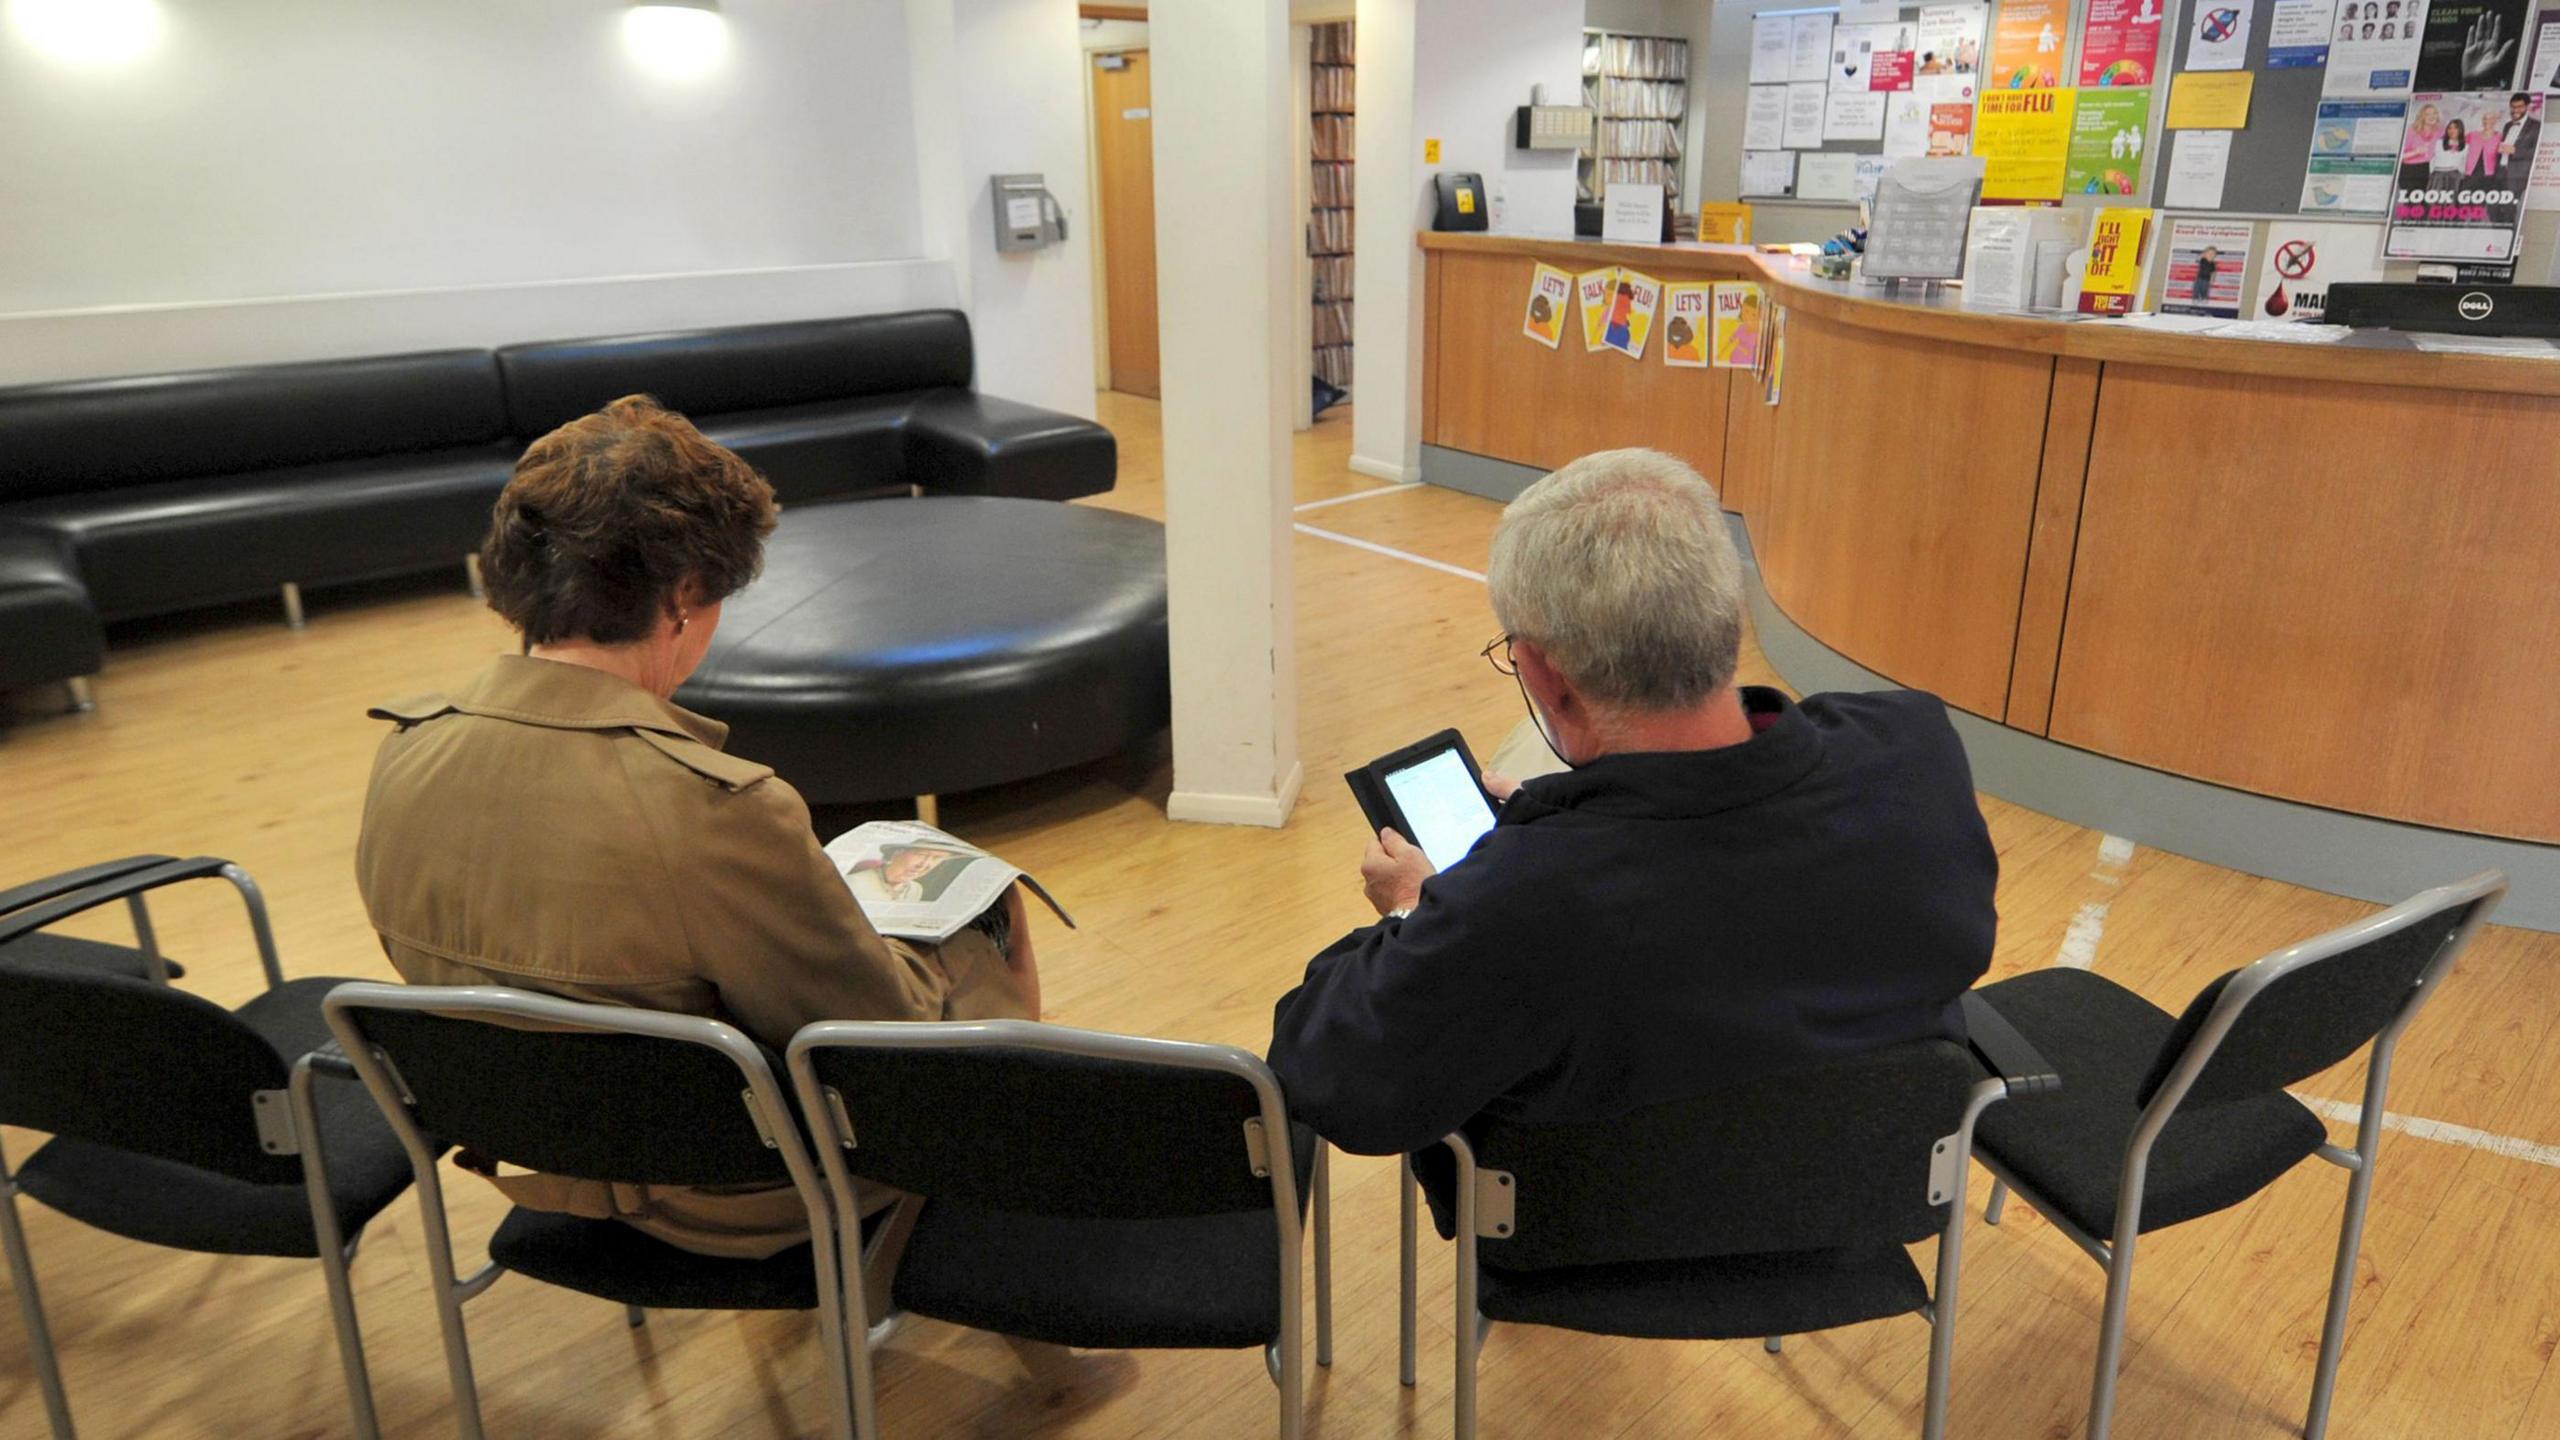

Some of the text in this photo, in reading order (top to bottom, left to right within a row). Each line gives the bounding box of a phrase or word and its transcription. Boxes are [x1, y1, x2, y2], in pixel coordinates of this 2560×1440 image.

[1982, 93, 2053, 113] TIME FOR FLU
[2398, 189, 2518, 205] LOOK GOOD.
[2396, 204, 2425, 219] DO
[2099, 222, 2120, 234] I'LL
[2100, 245, 2118, 263] IT
[1542, 274, 1565, 298] LET'S
[1583, 279, 1604, 301] TALK
[1675, 293, 1702, 313] LET'S
[1718, 291, 1742, 313] TALK
[2461, 301, 2490, 311] DELL
